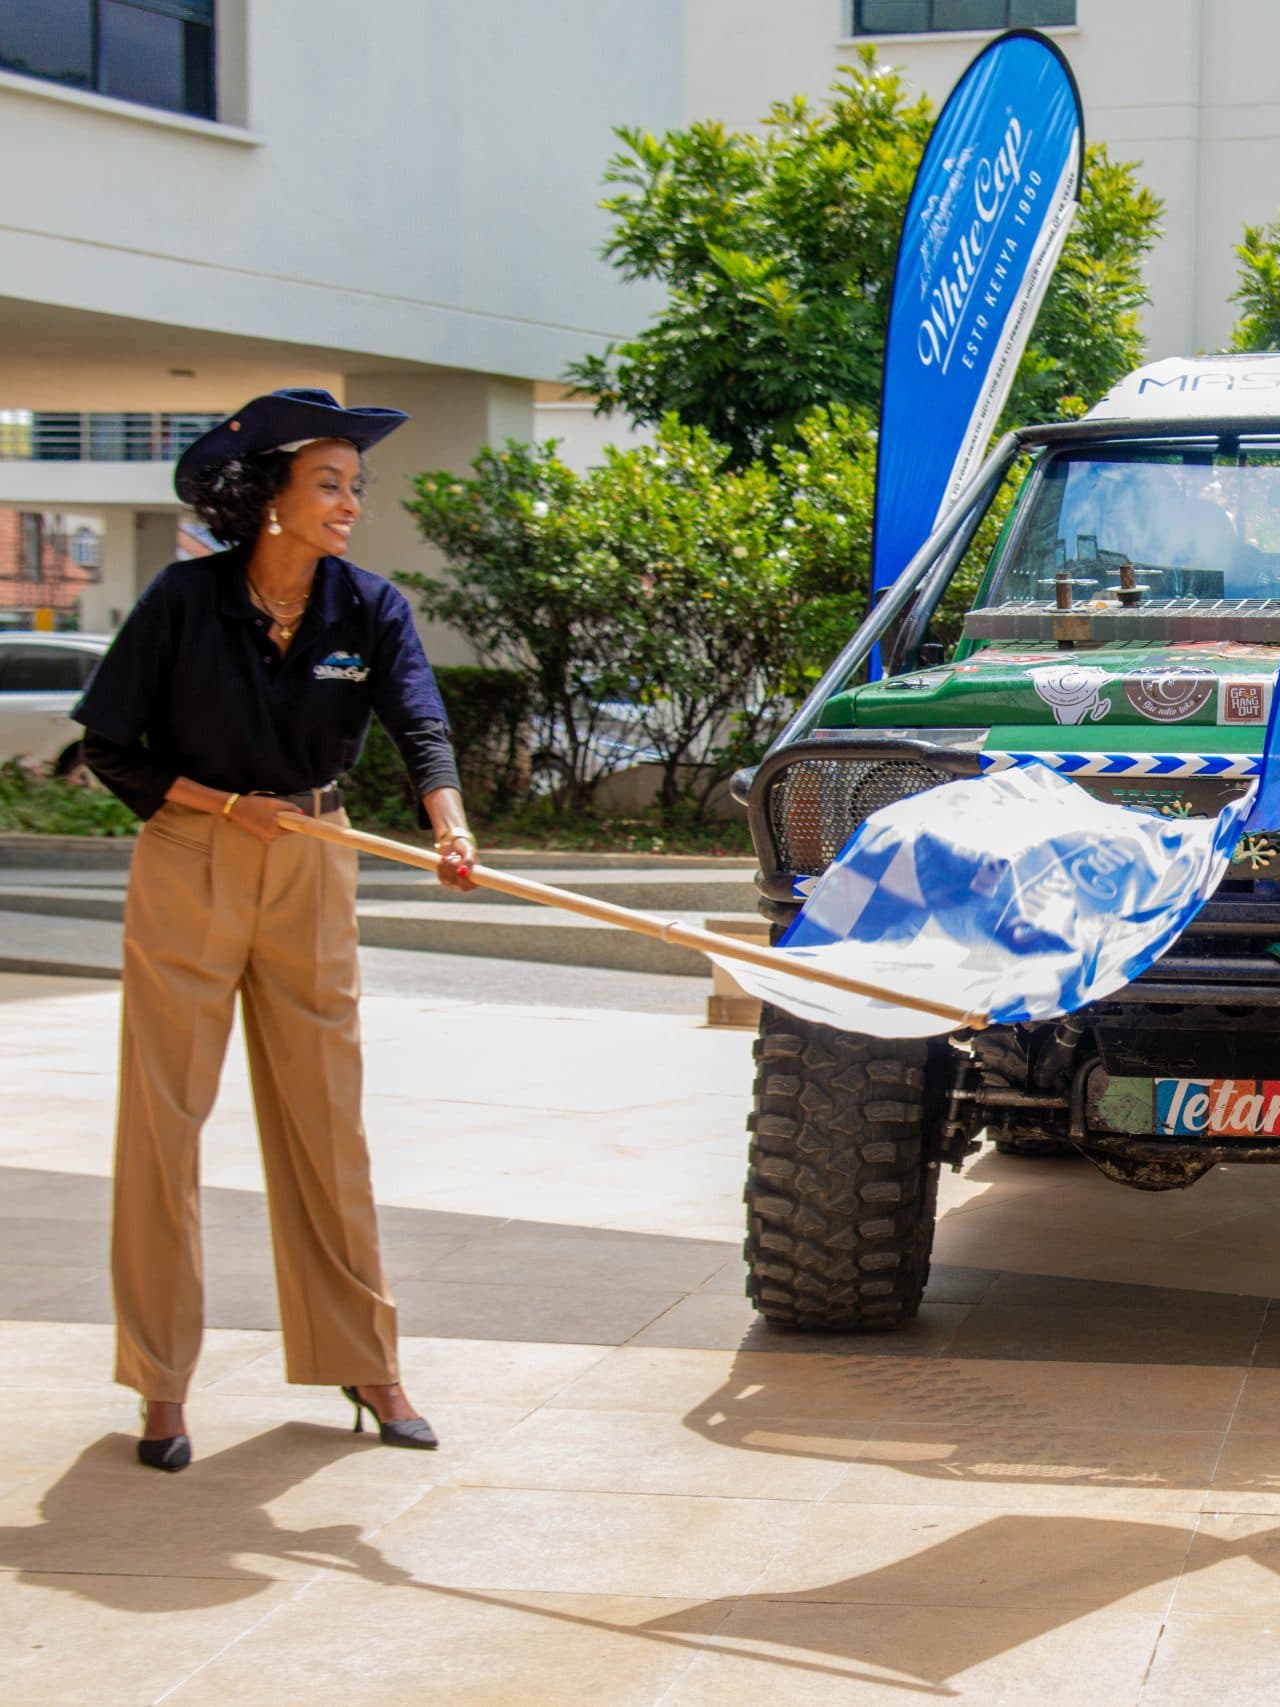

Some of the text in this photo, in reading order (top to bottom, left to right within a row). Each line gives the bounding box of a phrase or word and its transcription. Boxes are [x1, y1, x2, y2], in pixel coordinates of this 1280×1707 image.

[918, 117, 1021, 366] White Cap
[984, 237, 1019, 307] KENYA
[1231, 696, 1259, 709] HANG
[1238, 705, 1260, 717] OUT
